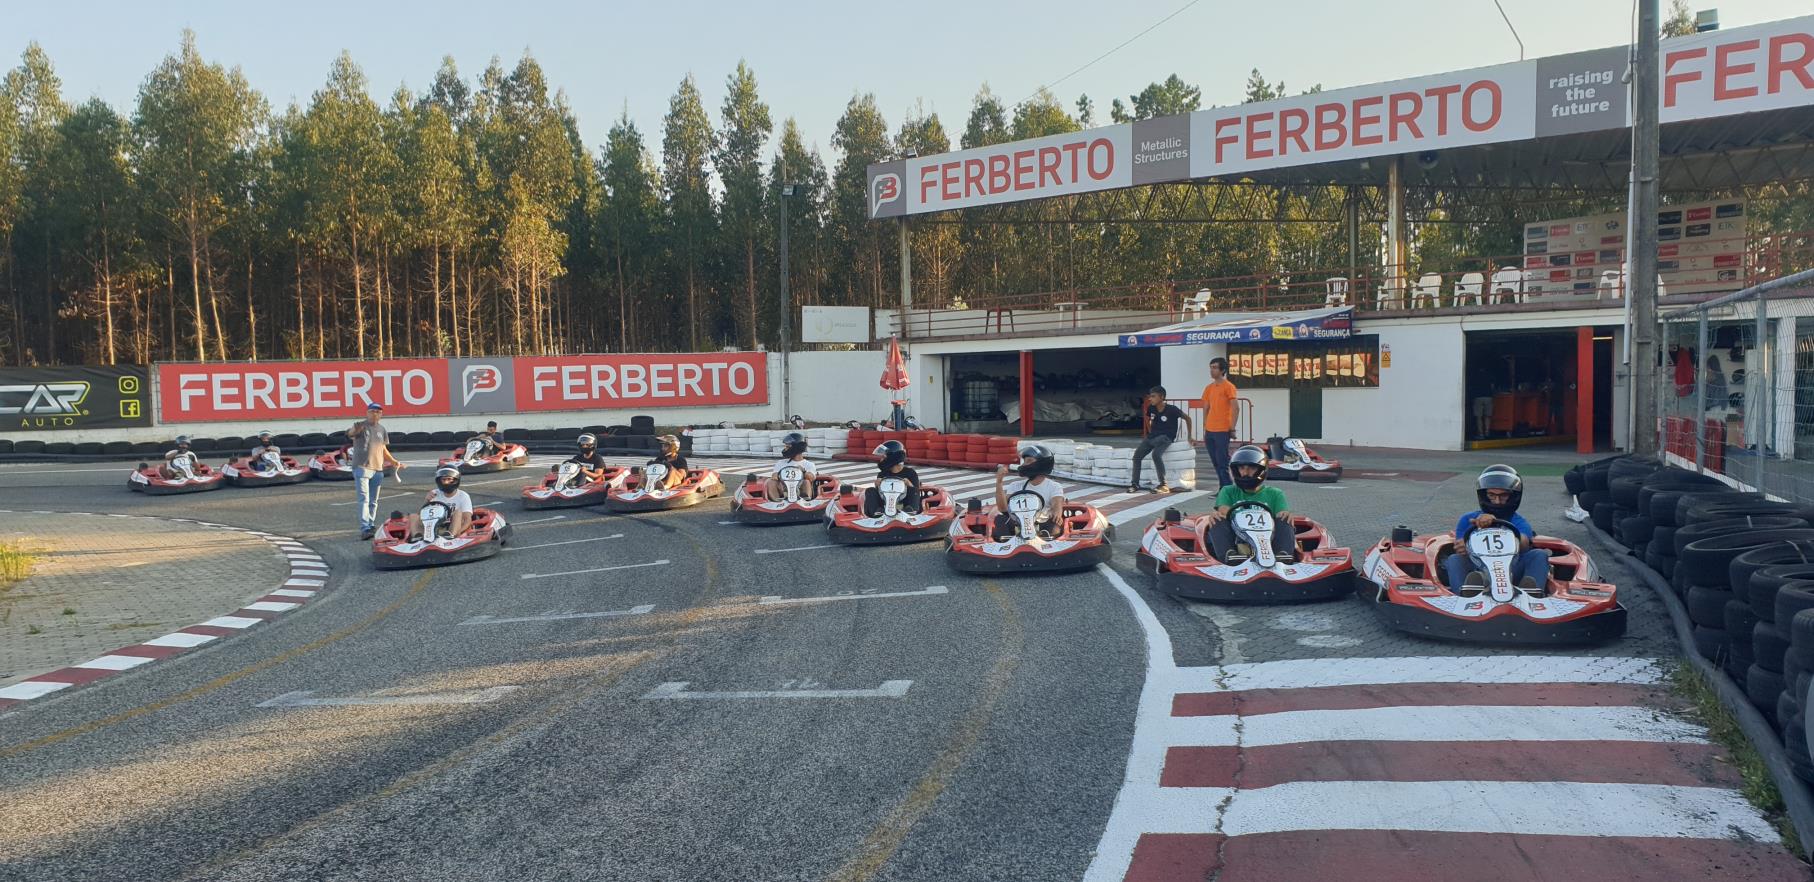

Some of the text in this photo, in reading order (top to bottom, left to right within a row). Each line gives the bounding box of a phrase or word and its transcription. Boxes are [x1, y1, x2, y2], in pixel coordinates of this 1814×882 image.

[1664, 32, 1814, 107] FER
[1549, 68, 1613, 89] raising
[1565, 85, 1595, 101] the
[1551, 99, 1610, 117] future
[1215, 79, 1502, 164] FERBERTO
[1141, 136, 1182, 153] Metallic
[1134, 147, 1188, 165] Structures
[920, 137, 1115, 204] FERBERTO
[1186, 331, 1241, 341] SEGURANÇA
[1313, 328, 1351, 338] SEGURANÇA
[533, 361, 755, 401] FERBERTO
[180, 368, 433, 412] FERBERTO
[21, 417, 74, 427] AUTO
[785, 470, 796, 479] 29
[889, 482, 894, 491] 1
[1016, 499, 1028, 509] 11
[428, 508, 434, 517] 5
[1245, 513, 1265, 526] 24
[1482, 535, 1504, 551] 15
